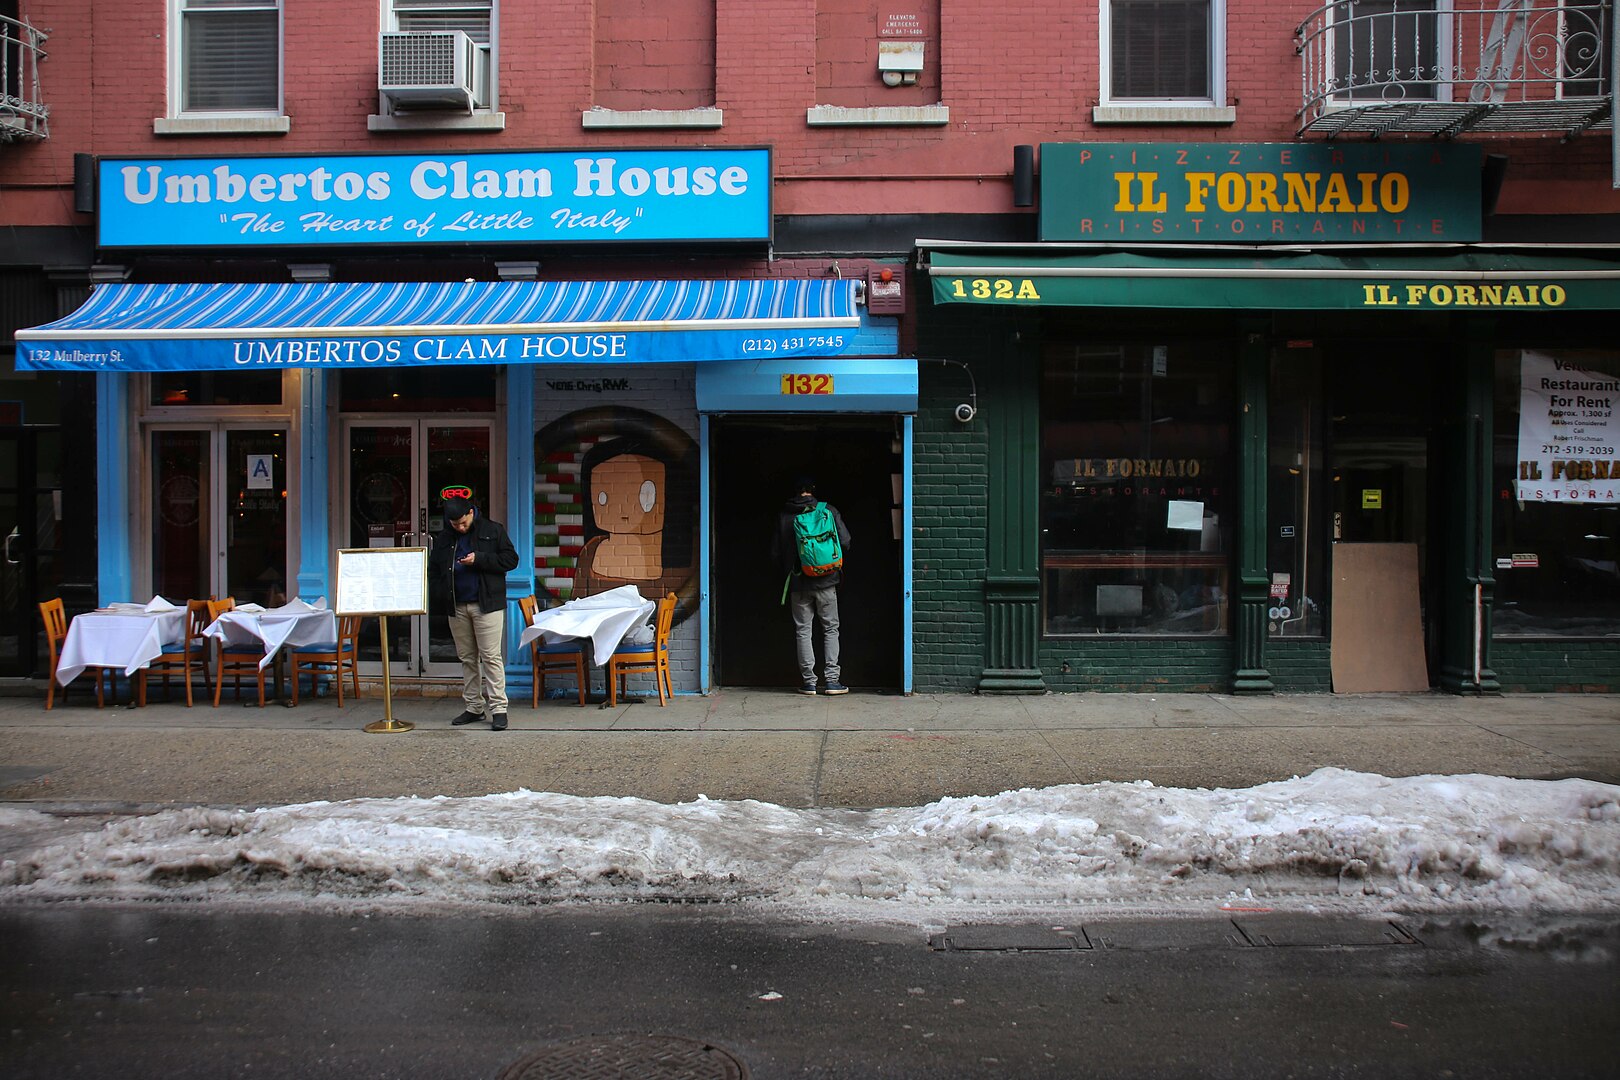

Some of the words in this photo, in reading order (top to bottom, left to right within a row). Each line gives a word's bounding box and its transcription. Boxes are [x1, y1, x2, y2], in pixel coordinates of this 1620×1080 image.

[121, 165, 391, 204] Umbertos
[410, 160, 553, 200] Clam
[573, 158, 748, 197] House
[1113, 172, 1167, 213] IL
[1184, 171, 1410, 213] FORNAIO
[219, 212, 286, 234] "The
[299, 211, 394, 233] Heart
[403, 211, 436, 238] of
[441, 210, 535, 232] Little
[549, 206, 644, 234] Italy"
[951, 279, 1041, 299] 132A
[1362, 285, 1398, 305] IL
[1405, 284, 1566, 306] FORNAIO
[233, 339, 401, 366] UMBERTOS
[413, 338, 508, 361] CLAM
[520, 334, 627, 358] HOUSE
[742, 338, 777, 354] (212)
[781, 337, 804, 350] 431
[808, 335, 843, 348] 7545
[28, 349, 51, 361] 132
[53, 349, 109, 365] Mulberry
[109, 349, 125, 361] St.
[785, 373, 829, 394] 132
[1541, 377, 1620, 391] Restaurant
[1550, 395, 1573, 407] For
[1577, 395, 1611, 408] Rent
[1548, 409, 1578, 418] Approx.
[1582, 410, 1603, 418] 1,300
[1604, 410, 1612, 418] sf
[253, 458, 269, 477] A
[1074, 458, 1095, 477] IL
[1106, 458, 1200, 478] FORNAIO
[1519, 460, 1542, 480] IL
